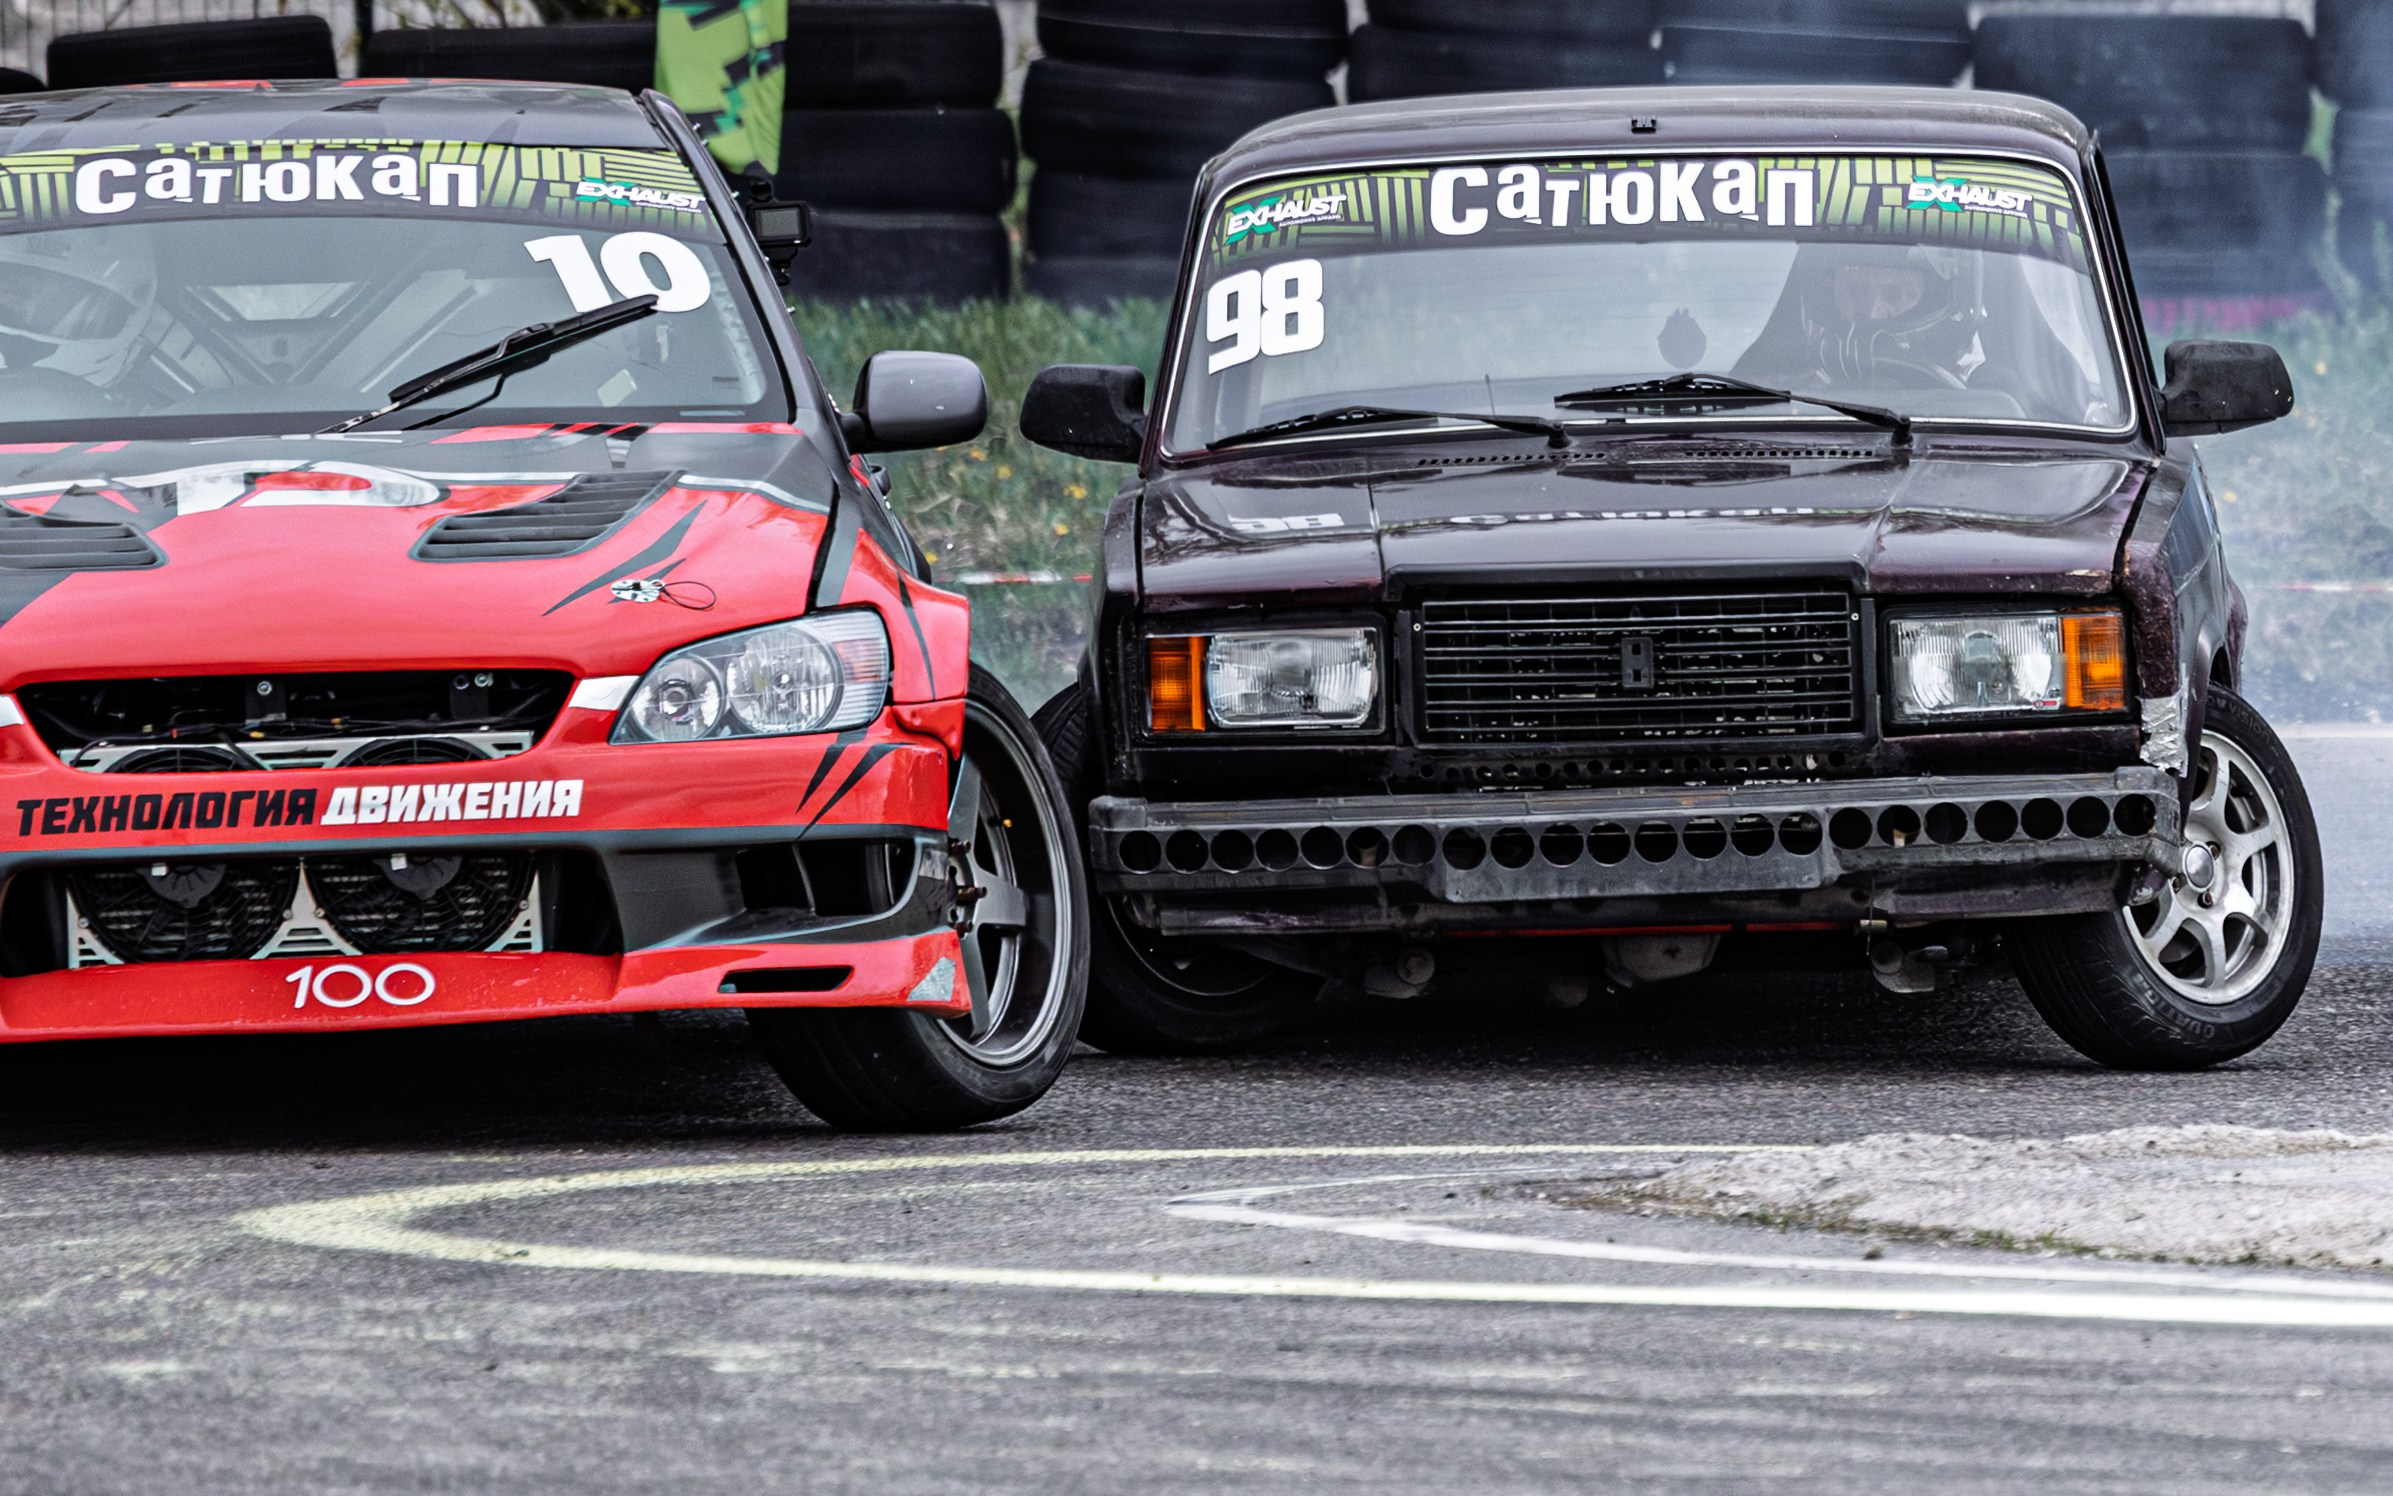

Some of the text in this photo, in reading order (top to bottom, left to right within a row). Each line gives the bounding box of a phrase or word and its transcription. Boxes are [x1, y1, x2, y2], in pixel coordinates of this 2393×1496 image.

[576, 178, 706, 208] EXHAUST
[1907, 178, 2032, 211] EXHAUST
[1225, 195, 1346, 241] EXHAUST
[524, 232, 711, 313] 10
[1206, 259, 1324, 375] 98
[17, 779, 583, 836] ТЕХНОЛОГИЯ ДВИЖЕНИЯ
[286, 963, 434, 1008] 100
